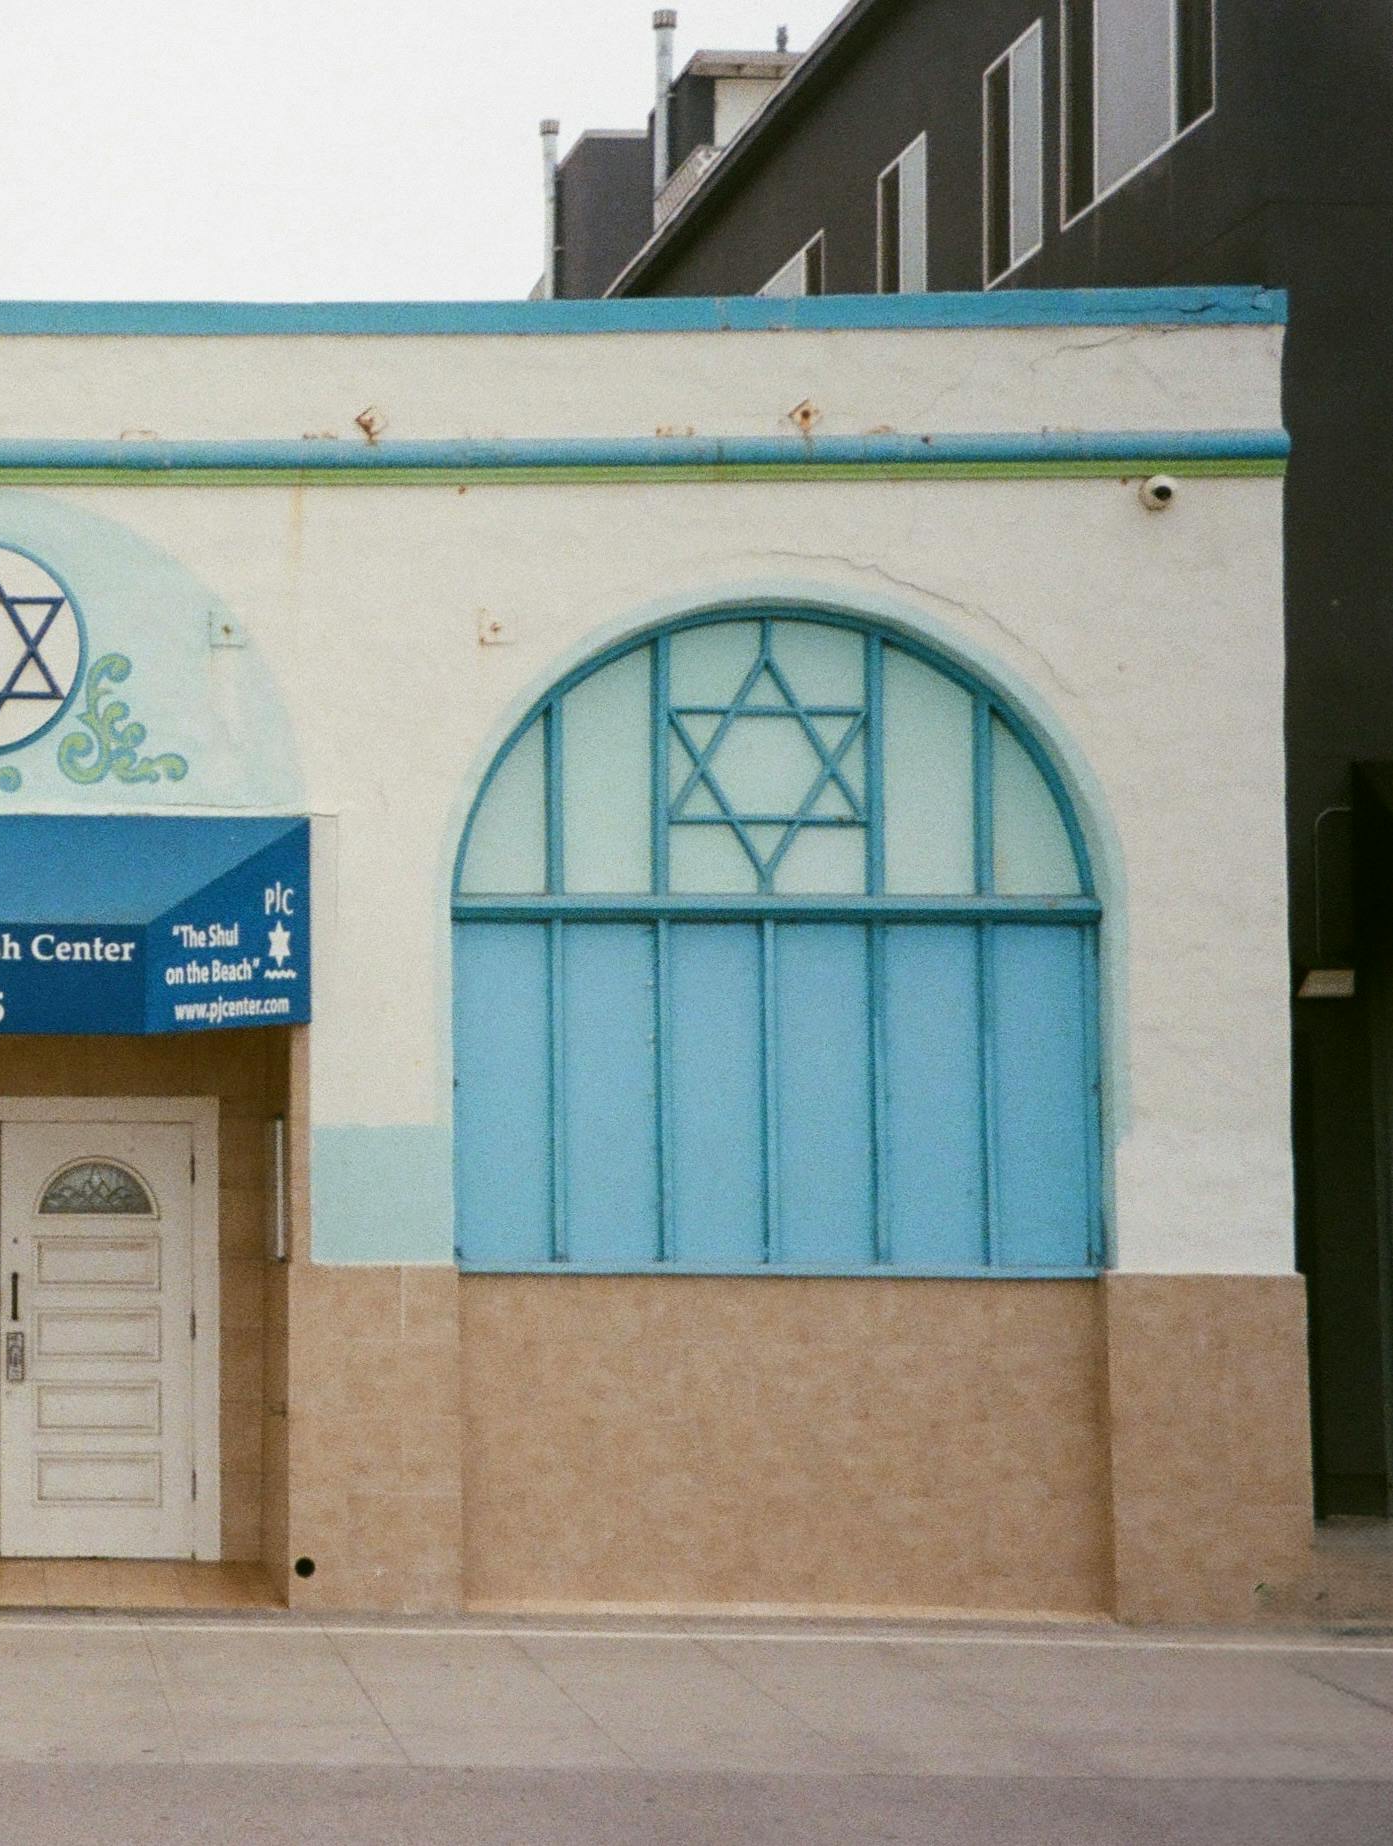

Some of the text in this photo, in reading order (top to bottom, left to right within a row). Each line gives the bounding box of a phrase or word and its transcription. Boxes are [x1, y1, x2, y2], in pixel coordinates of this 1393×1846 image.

[209, 922, 239, 947] Shul
[31, 934, 135, 962] Center
[165, 966, 184, 985] on
[186, 960, 209, 984] the
[174, 996, 290, 1024] www.pjcenter.com
